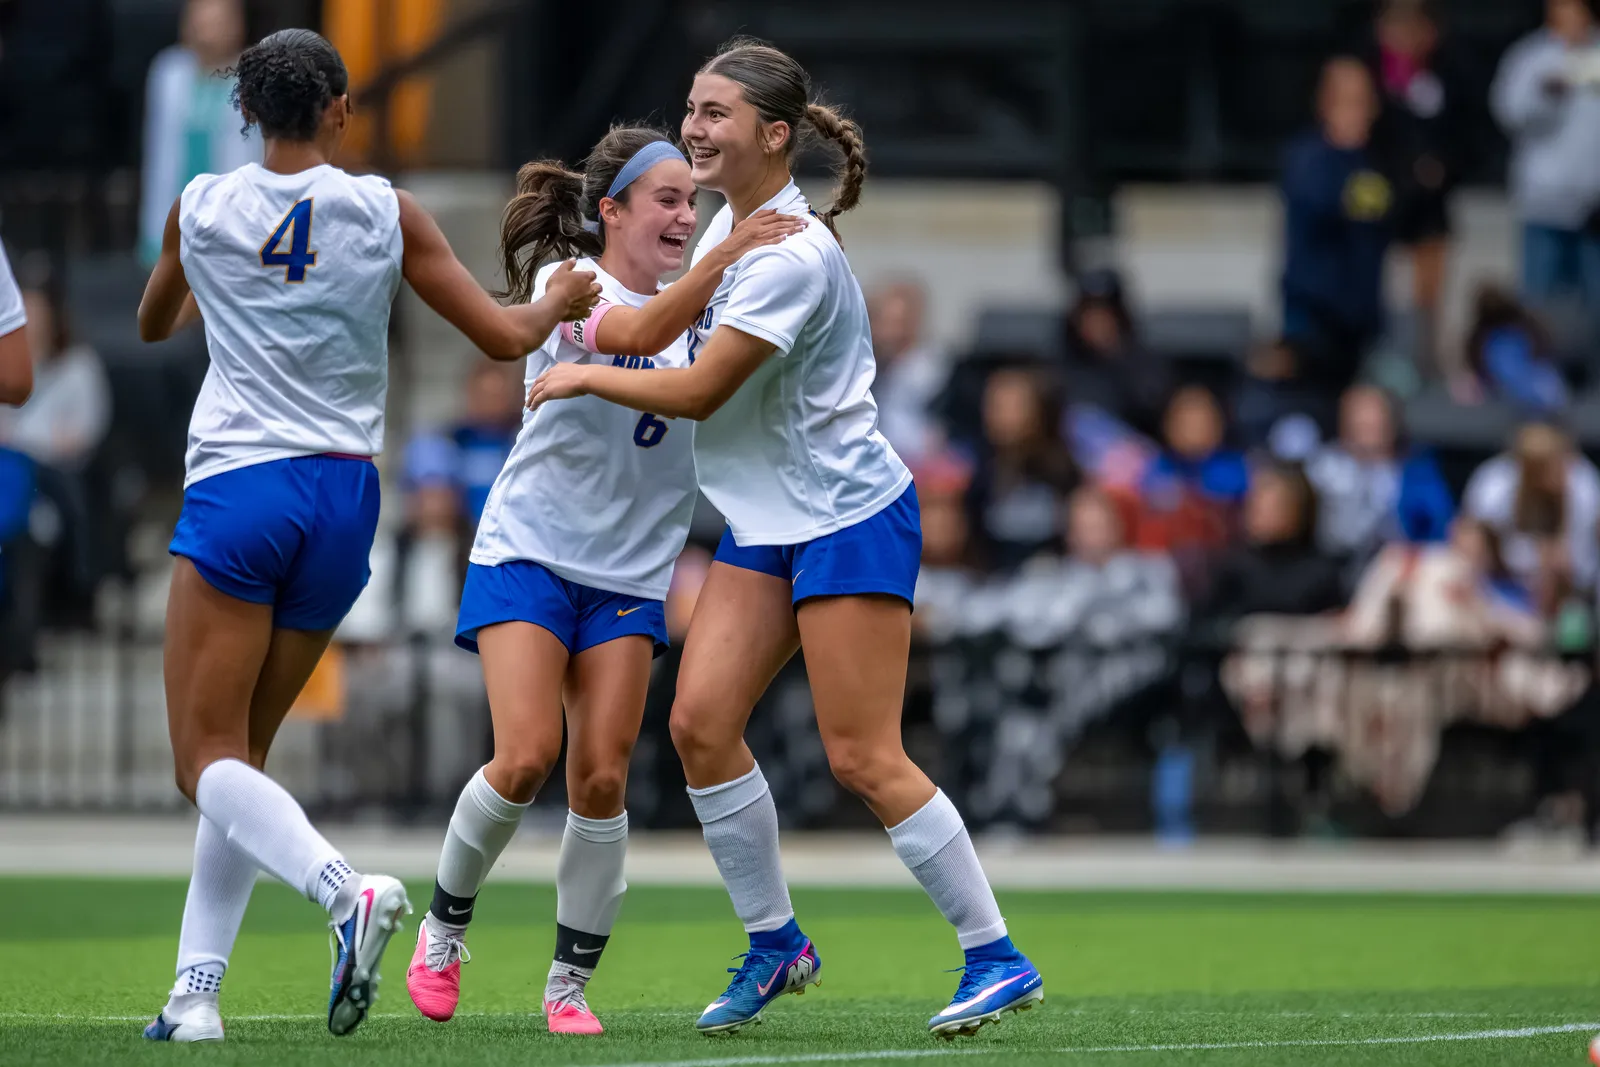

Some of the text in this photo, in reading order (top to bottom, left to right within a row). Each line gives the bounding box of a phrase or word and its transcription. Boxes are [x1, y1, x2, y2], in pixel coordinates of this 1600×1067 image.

[258, 196, 318, 284] 4
[574, 318, 587, 344] CAP
[633, 412, 669, 449] 6
